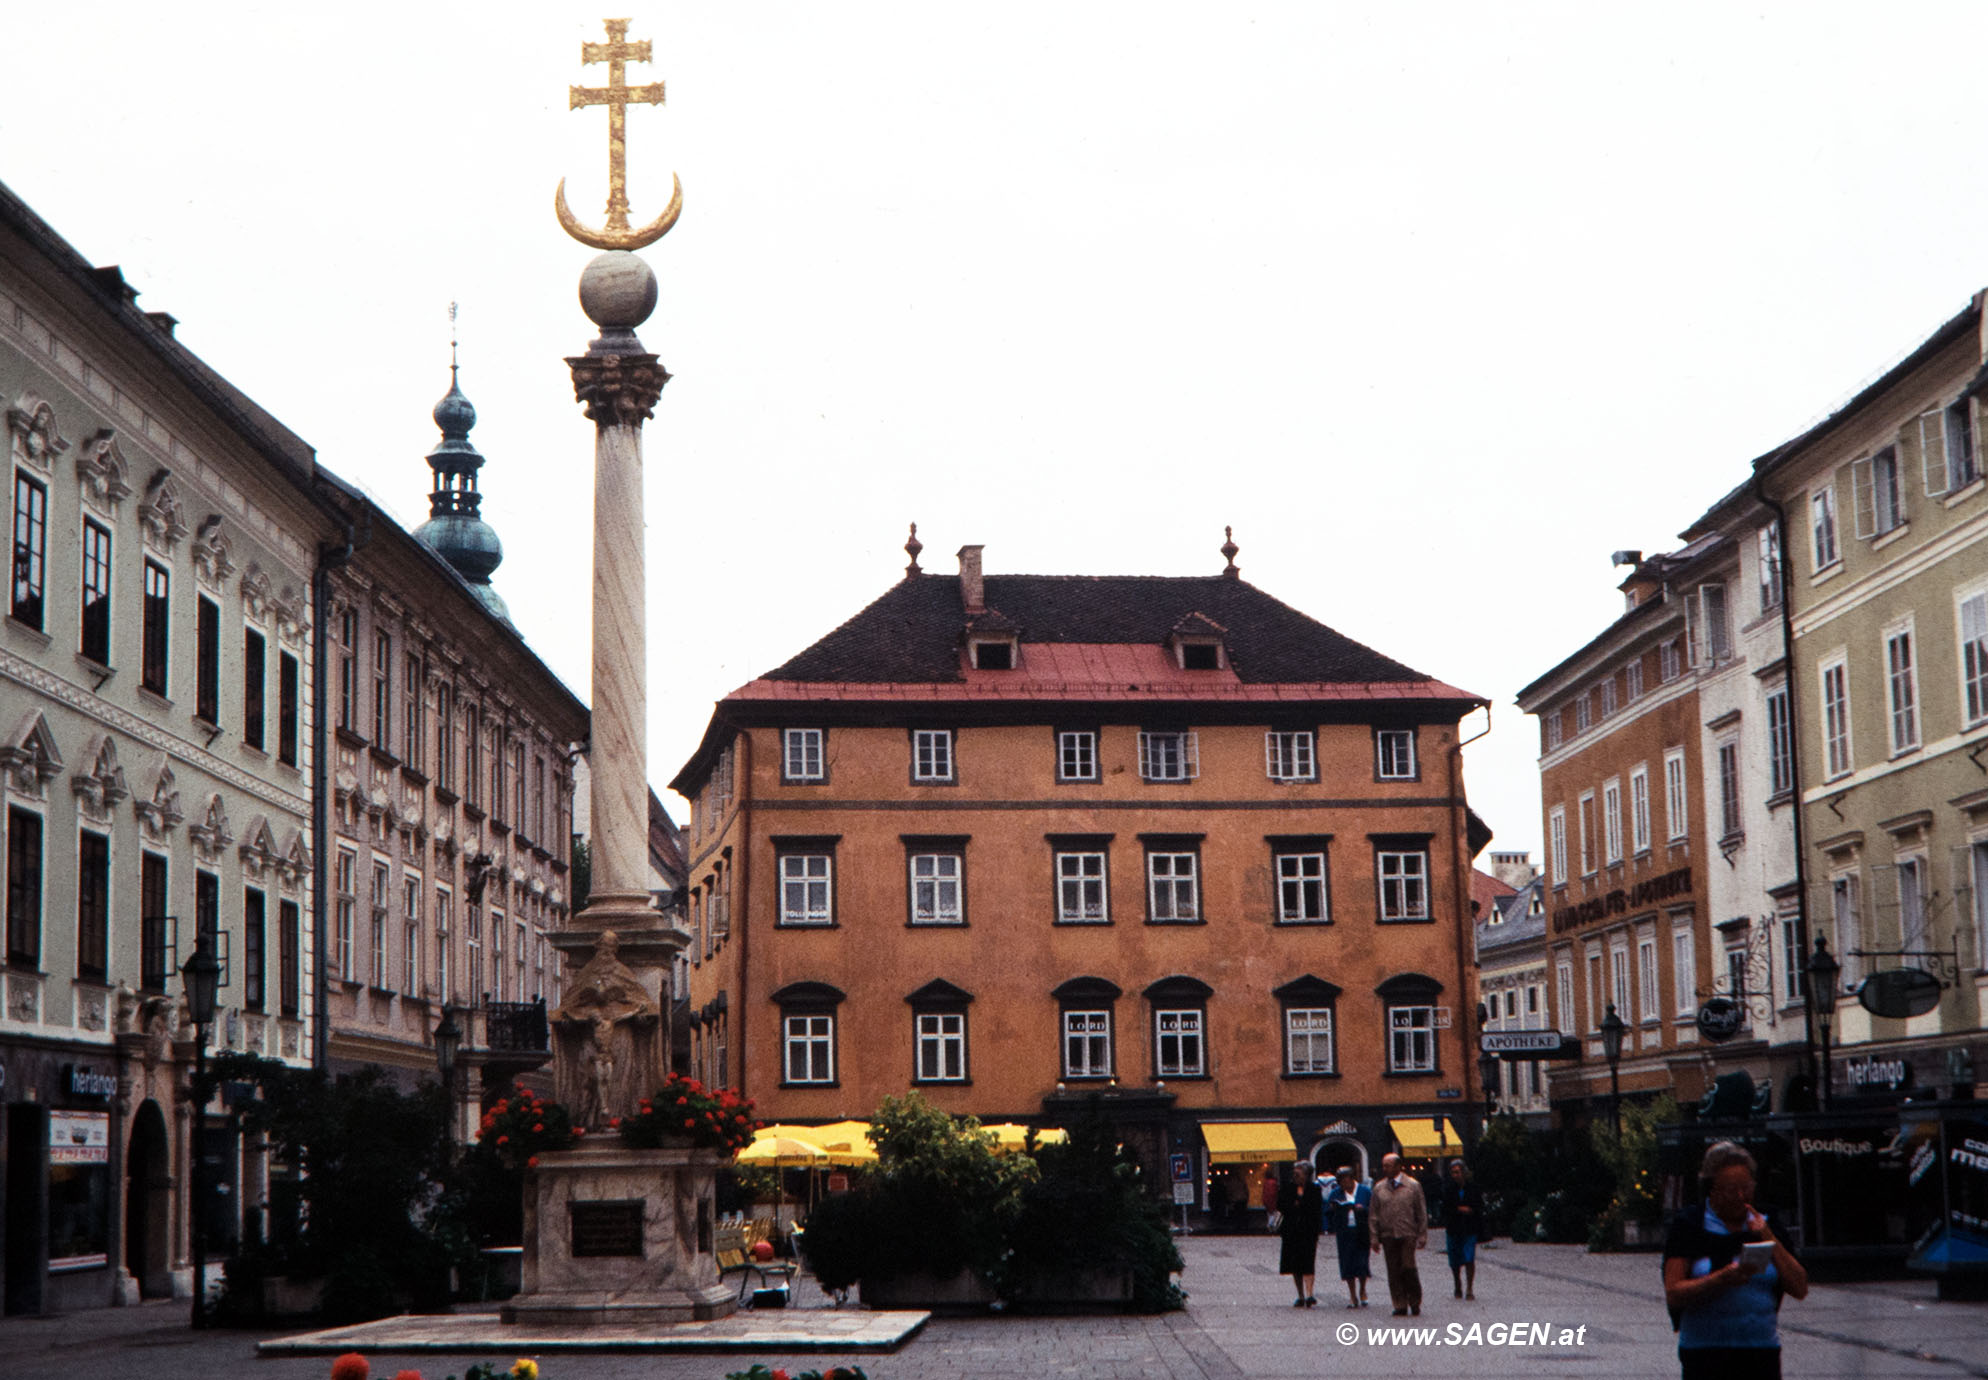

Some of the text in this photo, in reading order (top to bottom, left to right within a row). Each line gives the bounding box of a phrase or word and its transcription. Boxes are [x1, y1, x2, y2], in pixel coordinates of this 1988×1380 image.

[1487, 1036, 1554, 1048] APOTHEKE
[72, 1064, 118, 1102] herlango
[1847, 1055, 1904, 1090] herlango
[1800, 1137, 1873, 1156] Boutique
